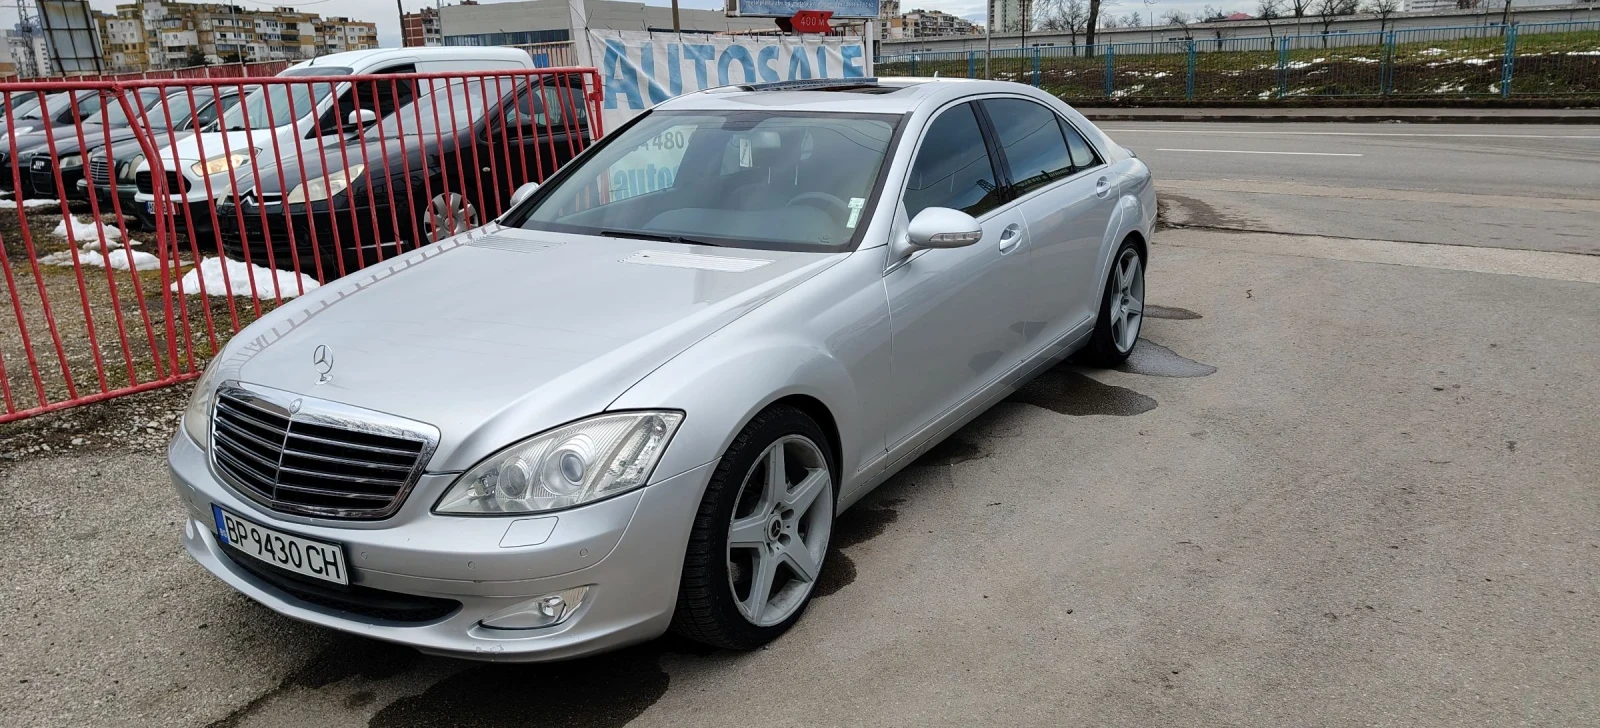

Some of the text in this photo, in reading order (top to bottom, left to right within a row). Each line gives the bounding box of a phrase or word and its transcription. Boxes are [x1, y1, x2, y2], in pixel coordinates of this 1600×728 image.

[800, 16, 817, 26] 400
[225, 515, 341, 580] BP 9430 CH
